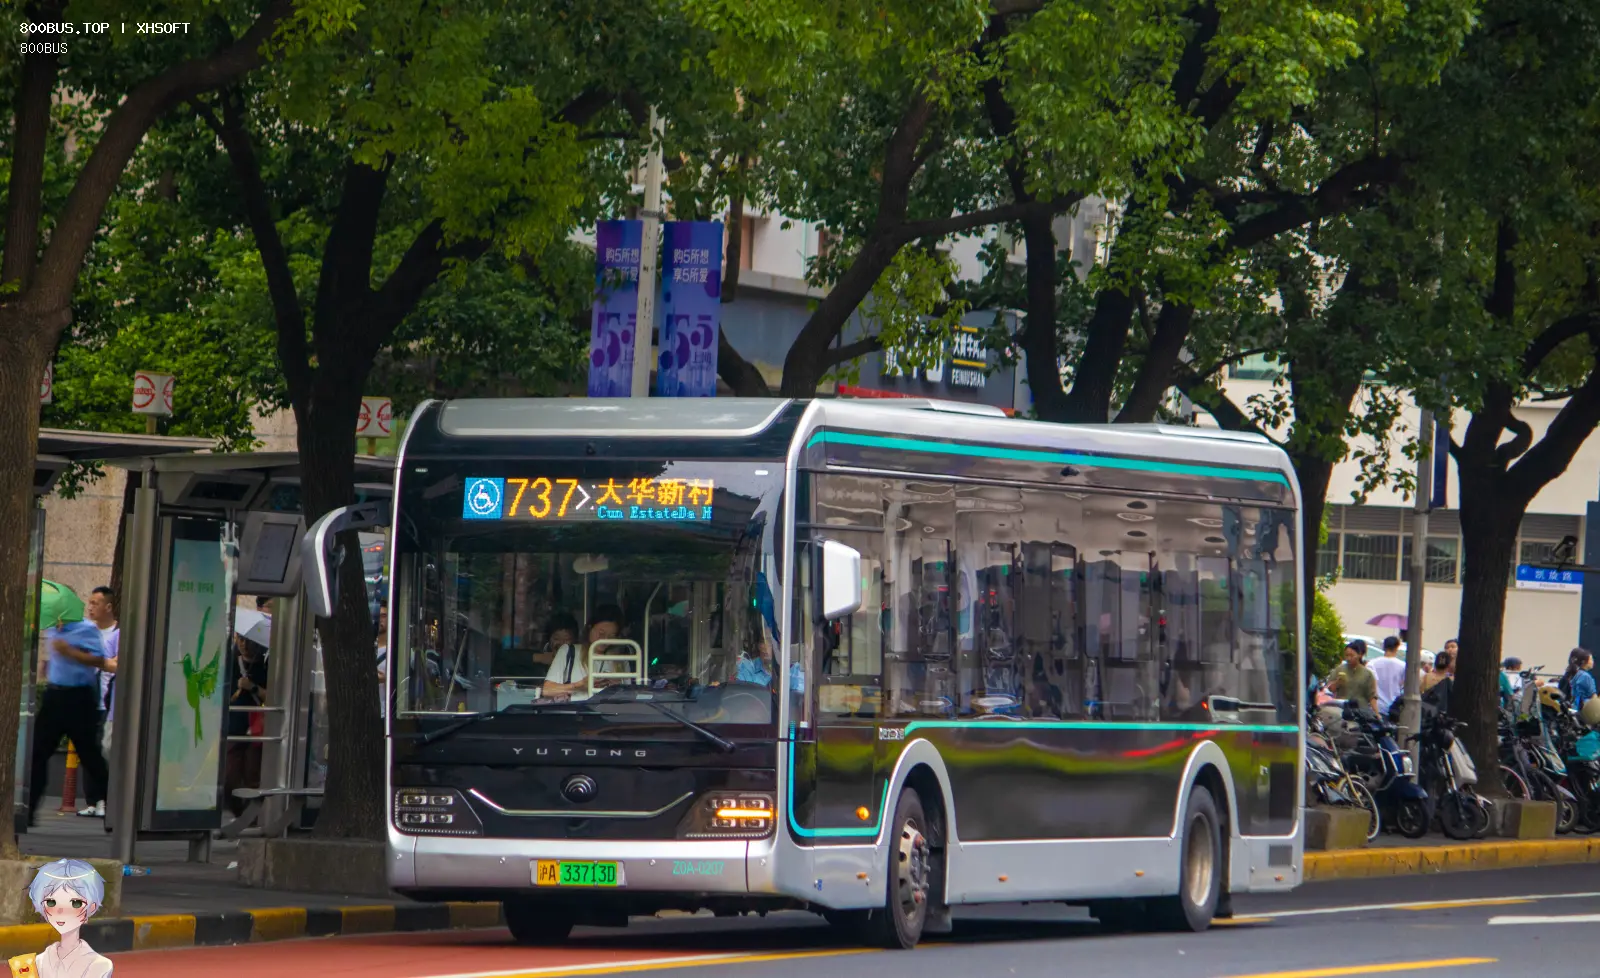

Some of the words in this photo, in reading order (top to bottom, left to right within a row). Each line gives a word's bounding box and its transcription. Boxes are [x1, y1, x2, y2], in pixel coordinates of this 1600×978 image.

[605, 247, 640, 263] 购5所想
[673, 248, 710, 265] 购5所想
[673, 267, 709, 283] 享5所爱
[507, 478, 578, 518] 737
[596, 477, 714, 505] 大华新村
[597, 506, 624, 519] Cun
[512, 747, 647, 758] YUTONG
[563, 864, 616, 883] 33713D
